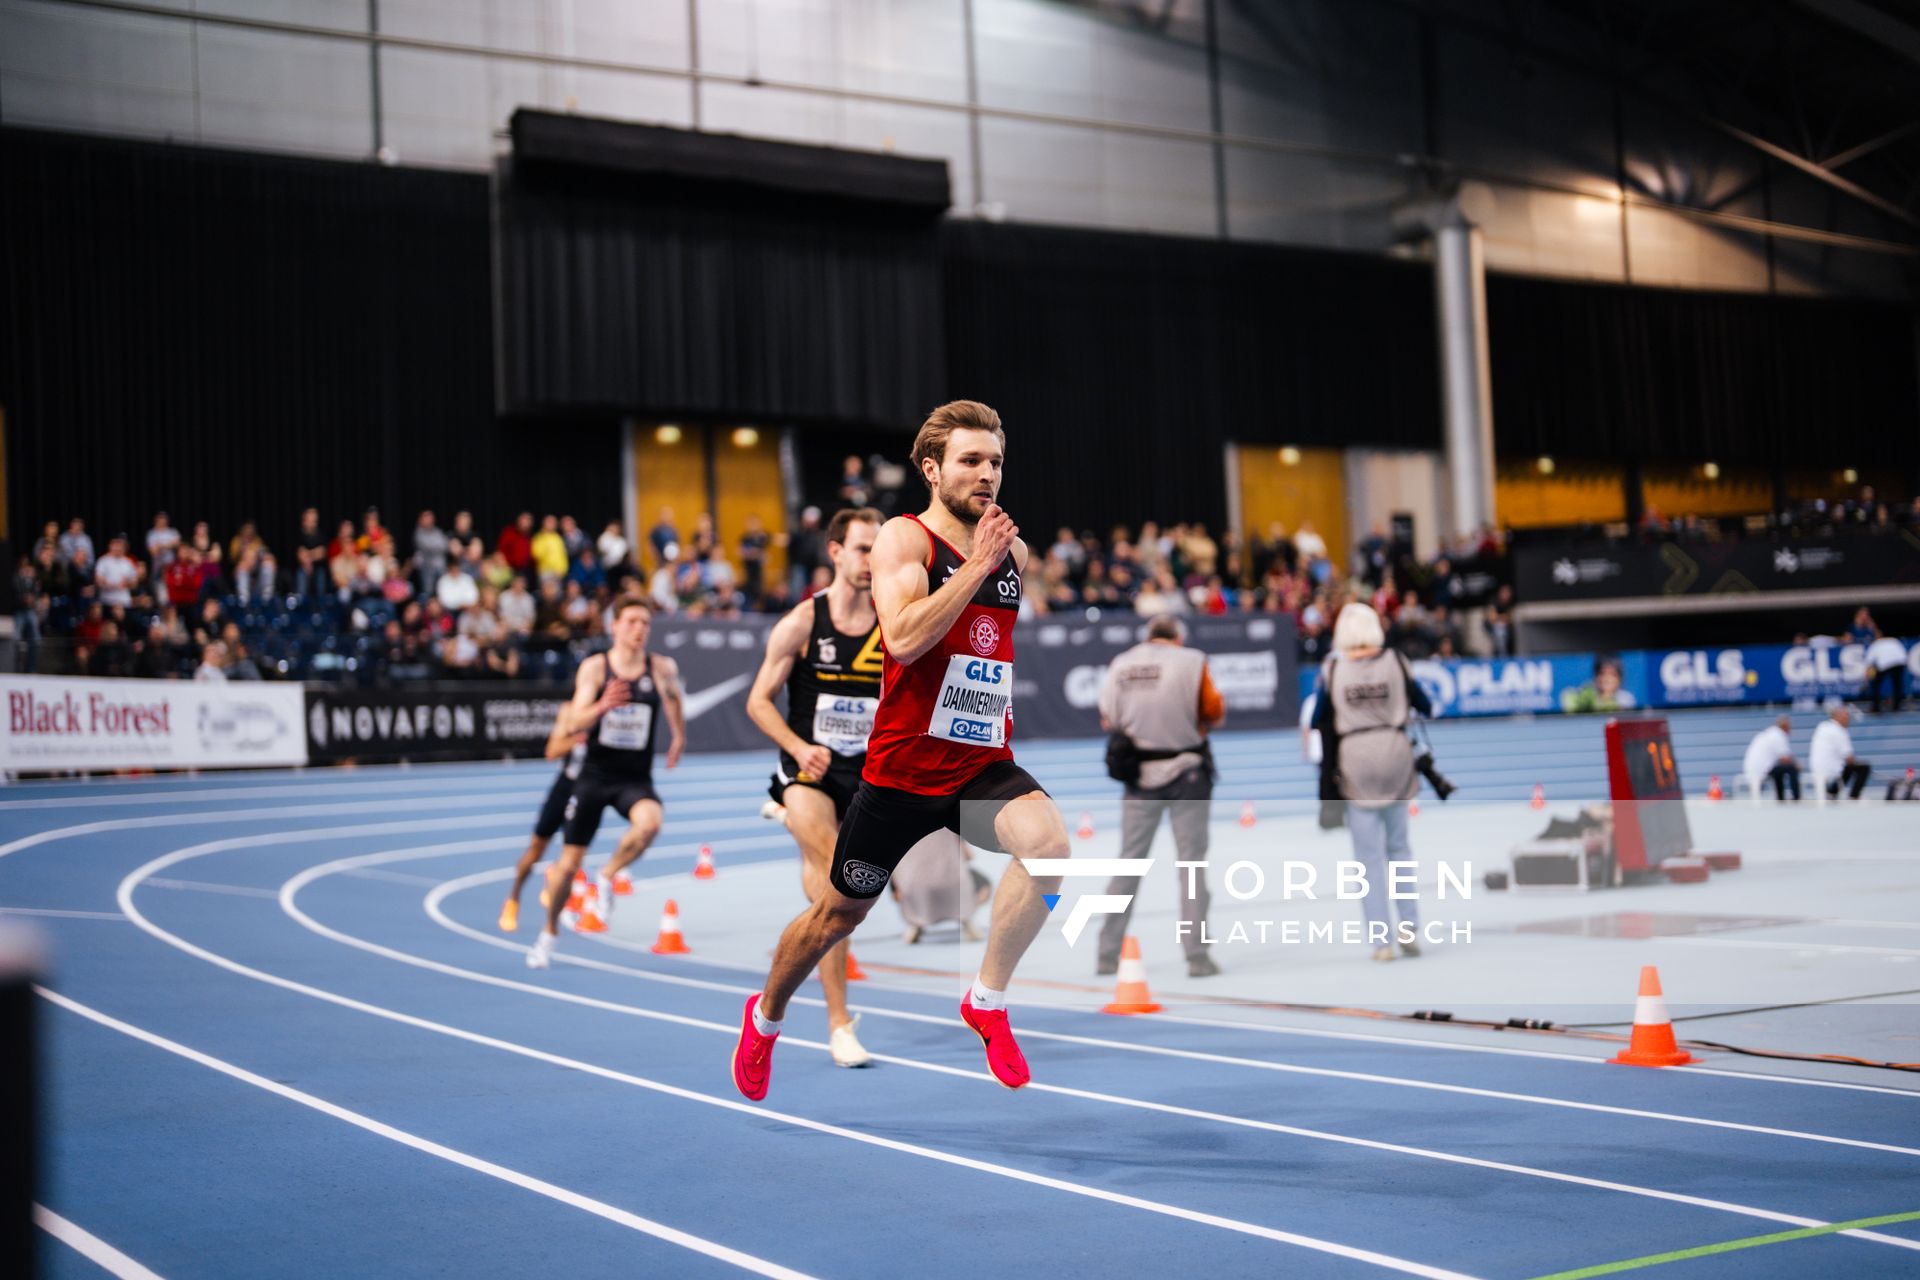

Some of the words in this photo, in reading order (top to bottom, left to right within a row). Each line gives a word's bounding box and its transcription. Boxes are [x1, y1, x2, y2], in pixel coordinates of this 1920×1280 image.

[997, 580, 1017, 597] OS
[965, 660, 1004, 685] GLS
[1457, 661, 1554, 695] PLAN
[1660, 649, 1746, 689] GLS
[1780, 644, 1866, 684] GLS
[9, 690, 81, 735] Black
[88, 692, 170, 734] Forest
[332, 704, 475, 740] NOVAFON
[833, 699, 866, 714] GLS
